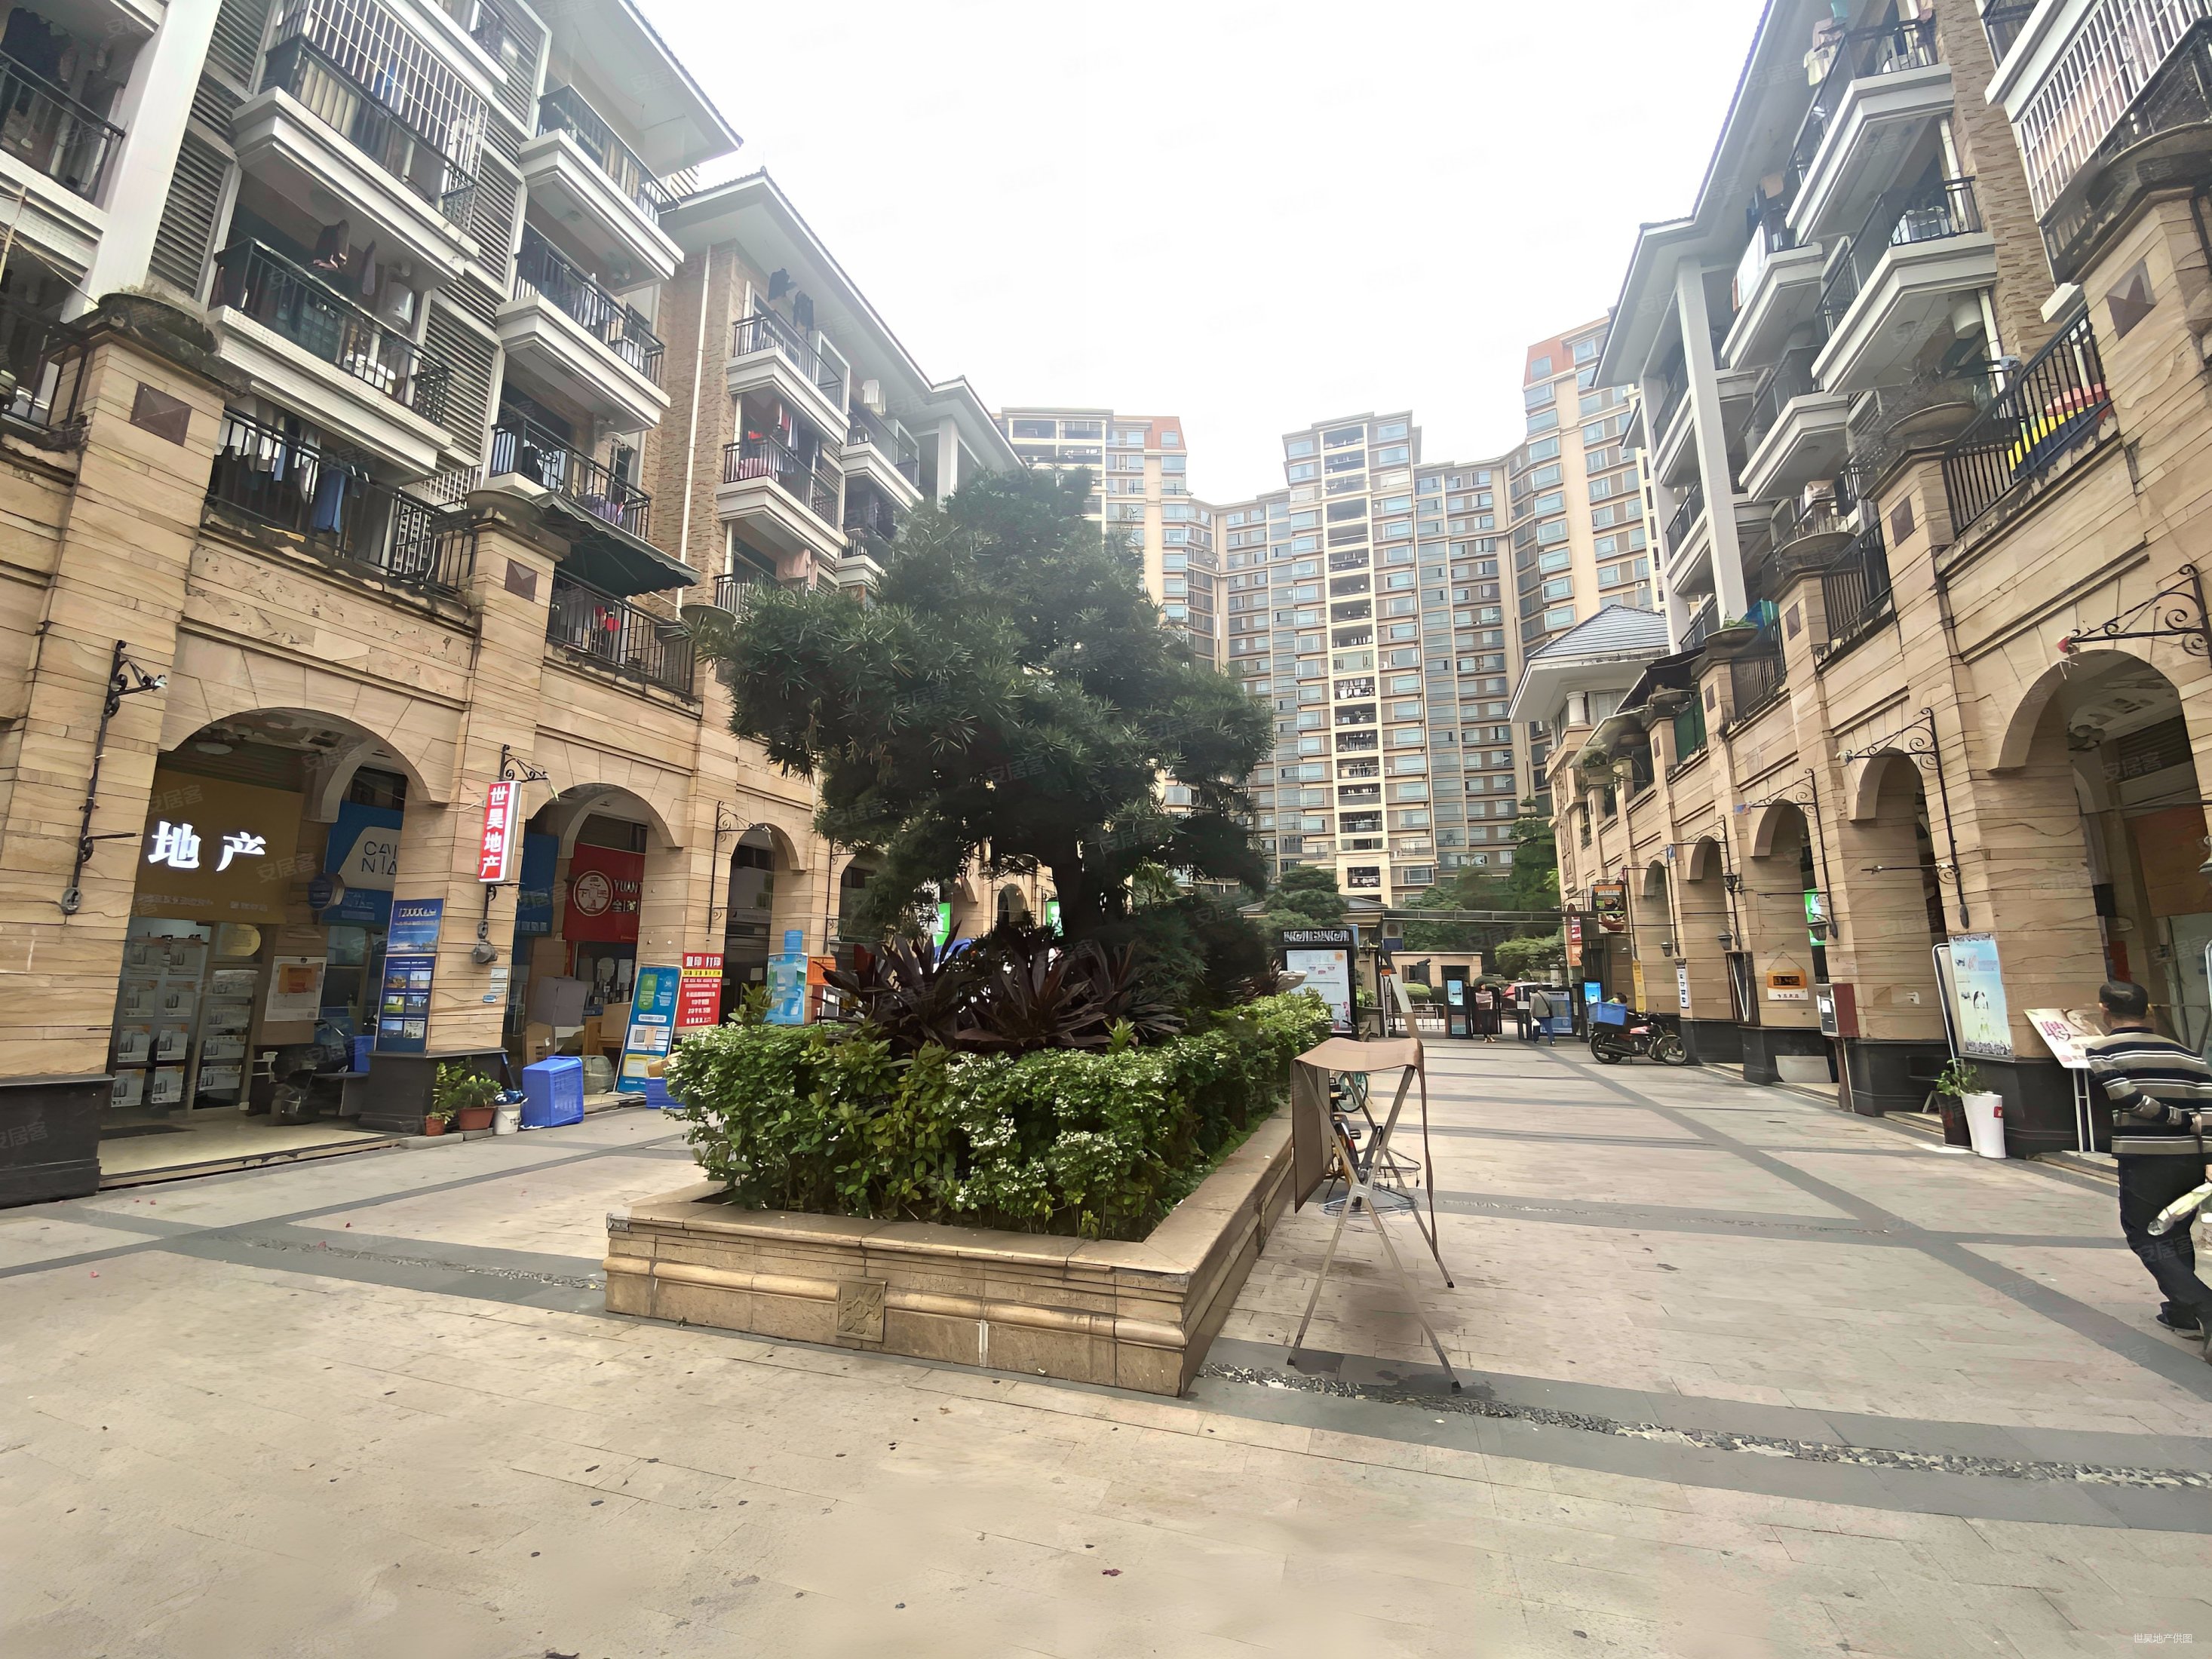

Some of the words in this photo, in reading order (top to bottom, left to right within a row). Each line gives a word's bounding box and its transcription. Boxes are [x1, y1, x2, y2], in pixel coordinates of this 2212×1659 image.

[148, 820, 267, 872] 地产
[480, 786, 508, 877] 世昊地产
